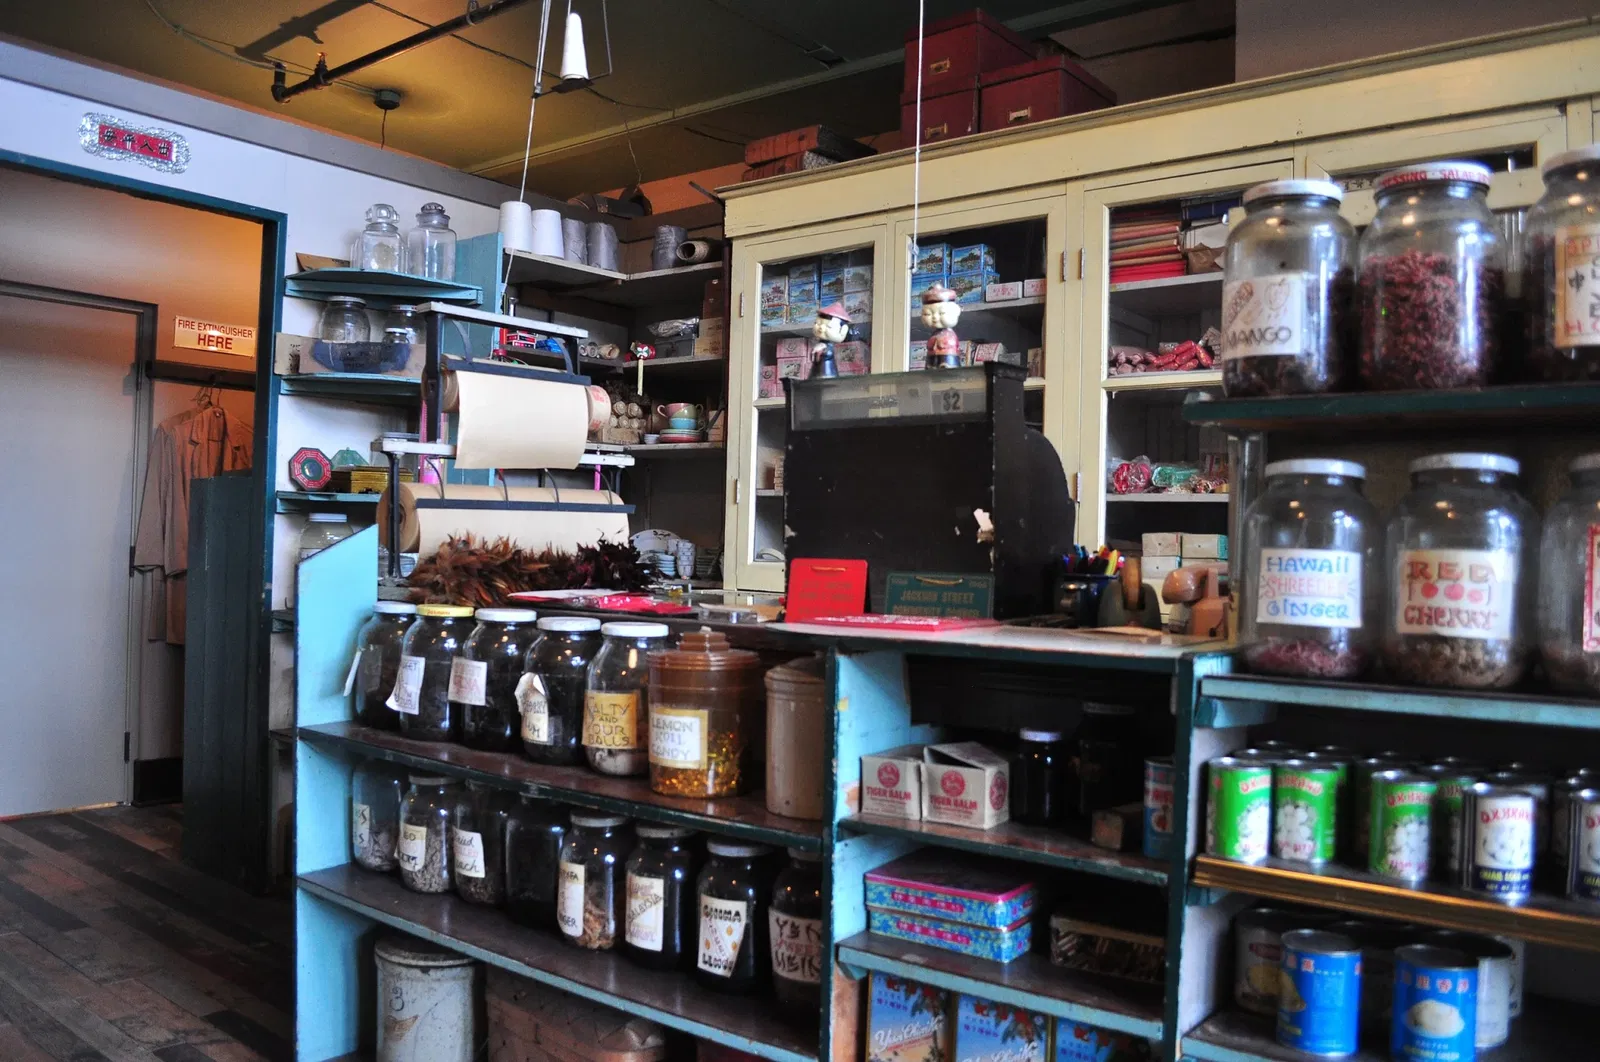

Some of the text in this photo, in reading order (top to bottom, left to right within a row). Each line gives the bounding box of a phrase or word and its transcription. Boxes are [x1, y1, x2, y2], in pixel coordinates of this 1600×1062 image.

[178, 319, 253, 338] FIRE EXTINGUISHER
[197, 333, 233, 350] HERE
[941, 591, 975, 604] STREET
[1266, 598, 1350, 619] GINGER
[598, 716, 618, 724] AND
[651, 716, 694, 733] LEMON
[588, 733, 630, 747] BALLS
[865, 786, 888, 798] TIGER
[888, 789, 912, 801] BALM
[930, 794, 979, 810] TIGER BALM
